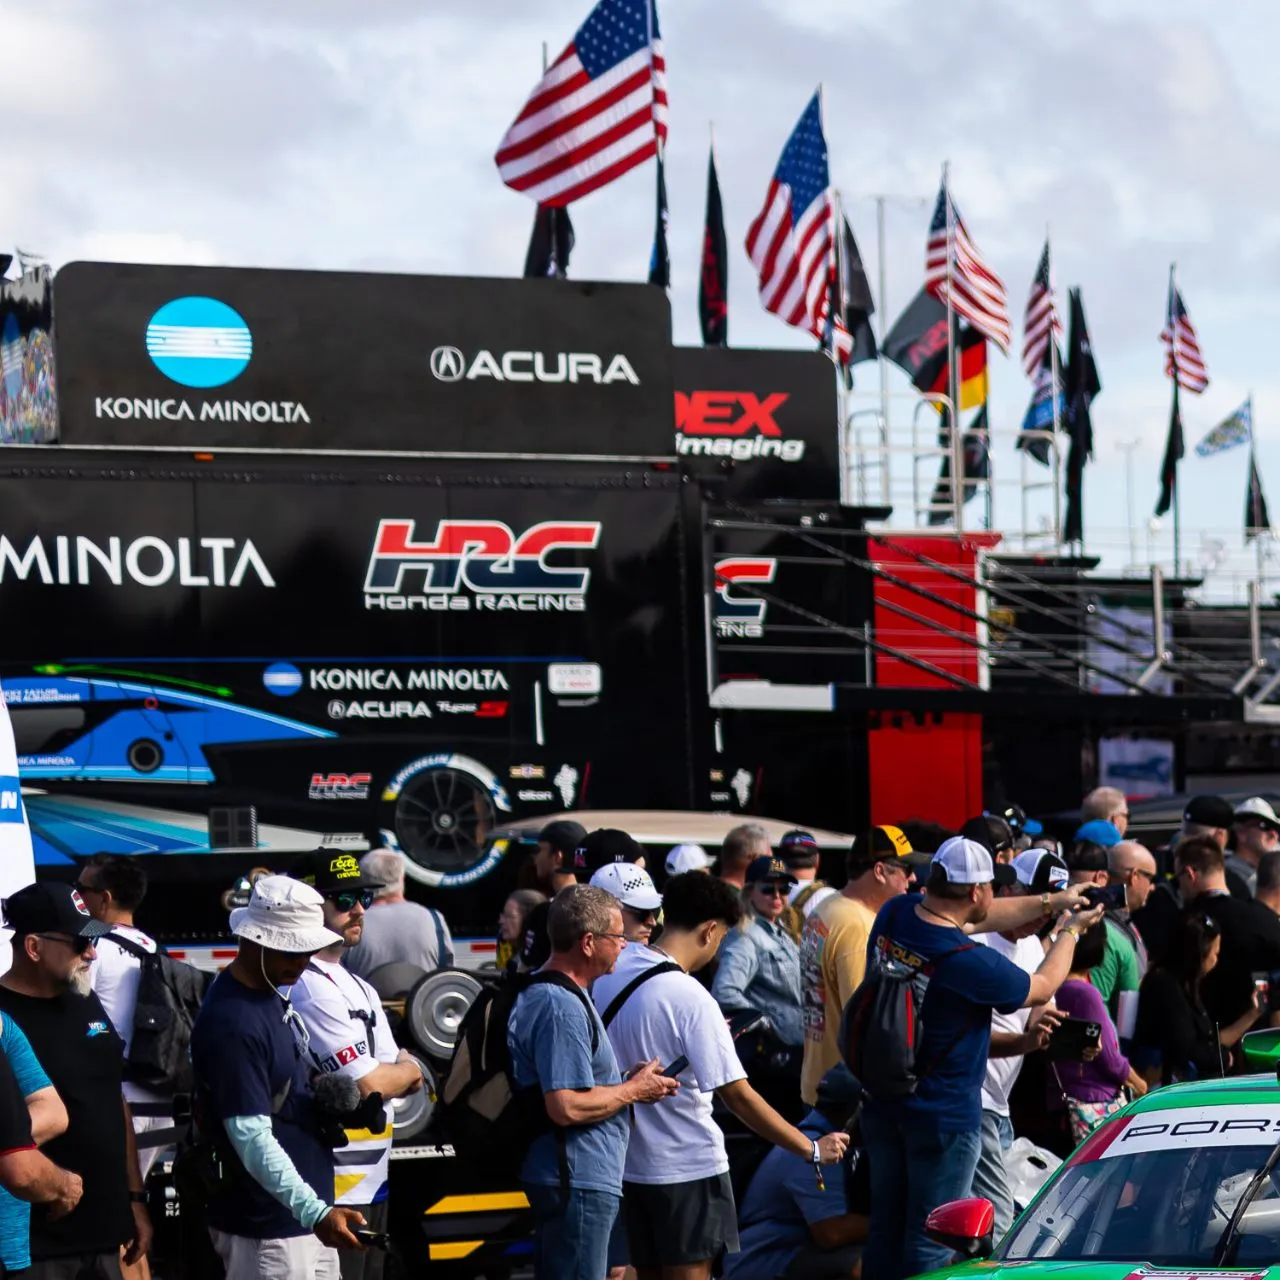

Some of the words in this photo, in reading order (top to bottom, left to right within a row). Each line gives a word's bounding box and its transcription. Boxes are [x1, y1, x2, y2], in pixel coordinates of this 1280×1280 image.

[466, 350, 641, 386] ACURA
[96, 397, 194, 421] KONICA
[200, 400, 311, 424] MINOLTA
[675, 432, 804, 462] imaging
[0, 534, 277, 587] MINOLTA
[364, 519, 602, 594] HRC
[365, 594, 470, 611] Honda
[475, 594, 586, 612] RACING
[310, 669, 403, 690] KONICA
[407, 669, 510, 691] MINOLTA
[345, 700, 433, 718] ACURA
[342, 1049, 355, 1062] 2
